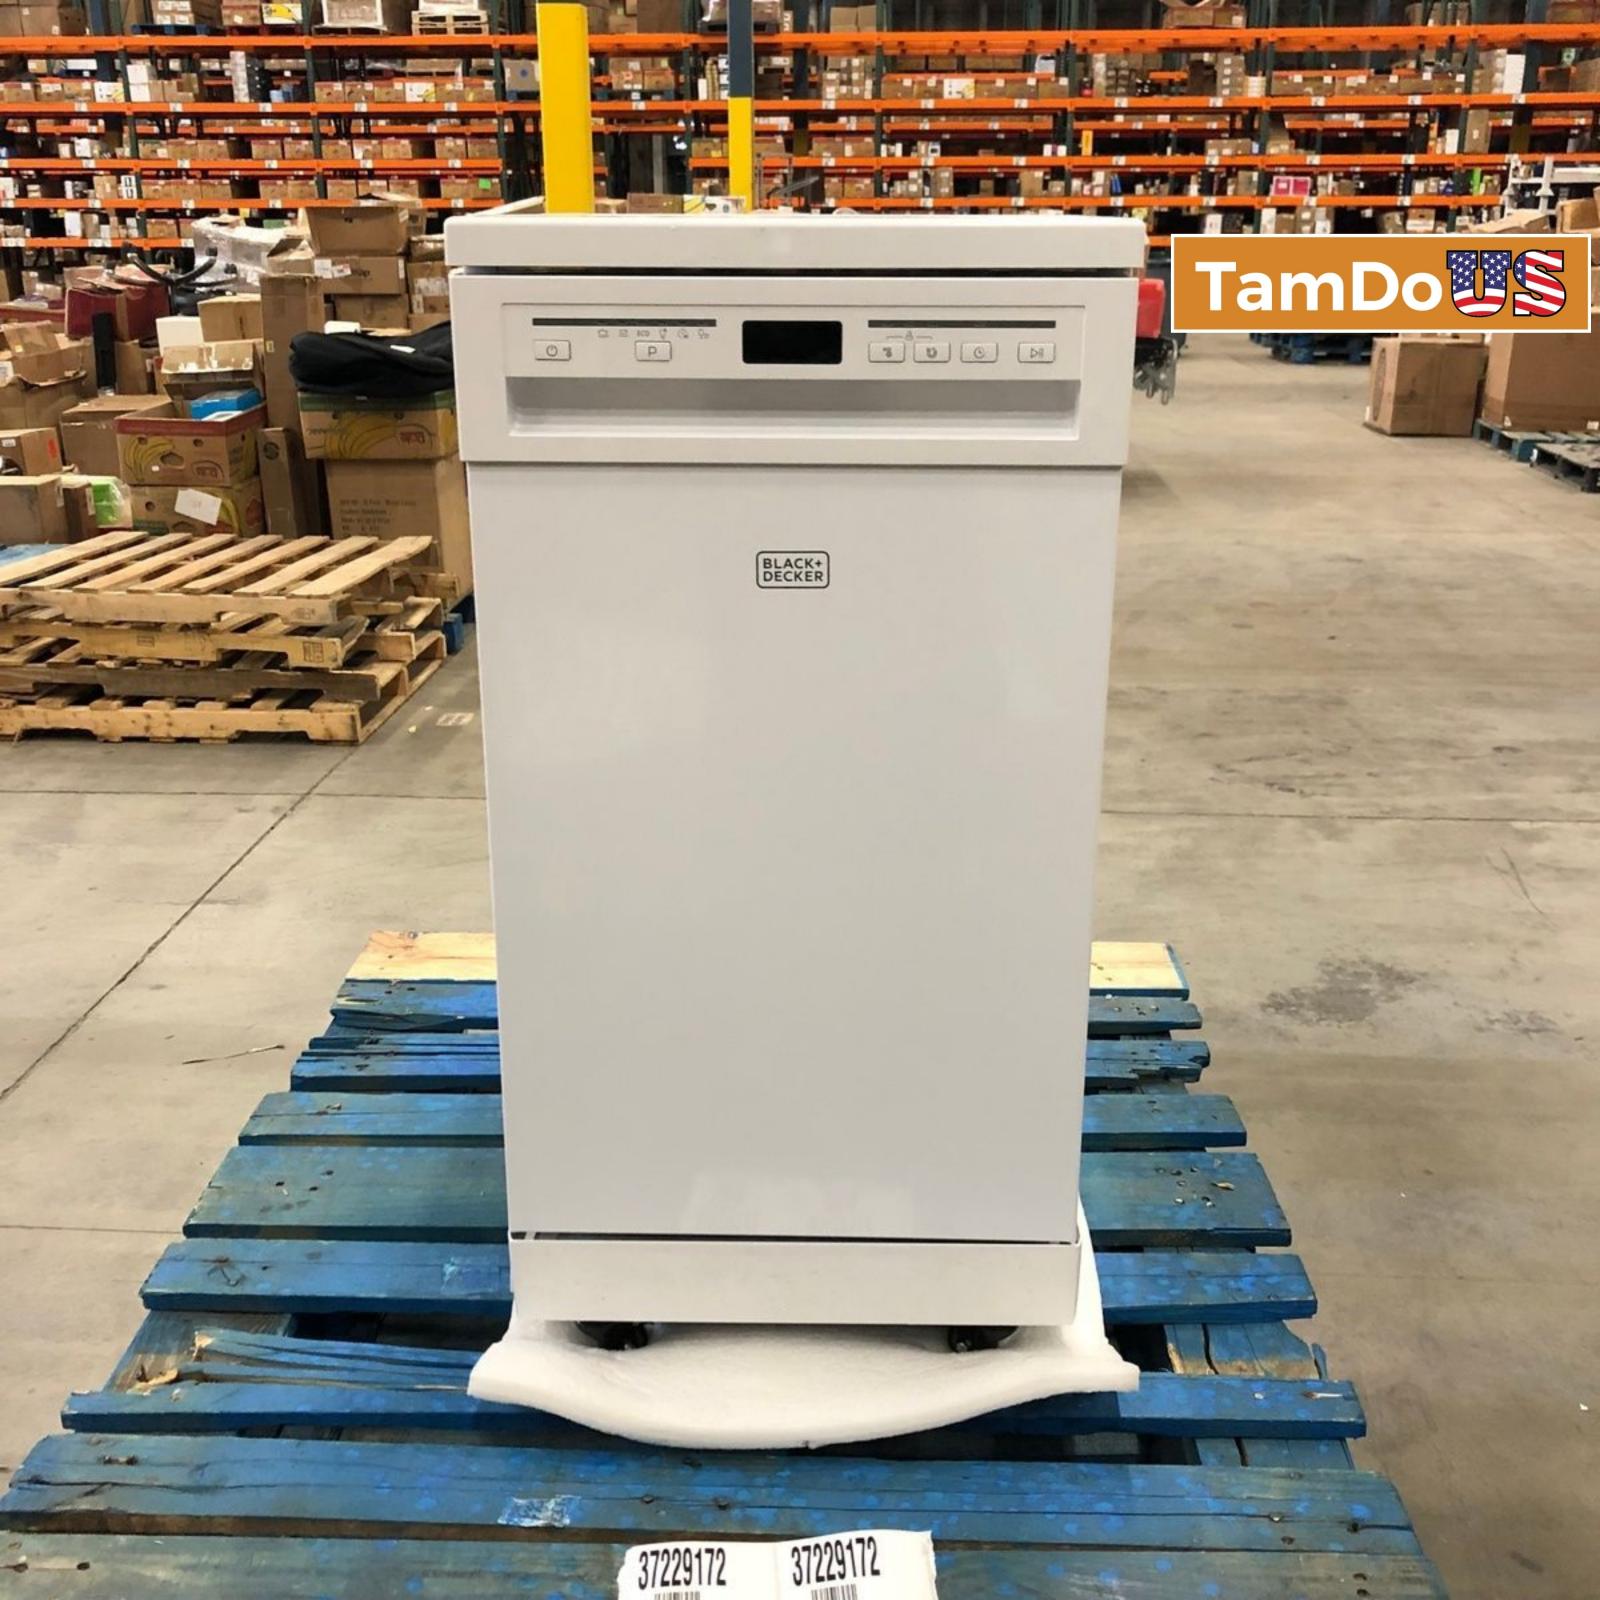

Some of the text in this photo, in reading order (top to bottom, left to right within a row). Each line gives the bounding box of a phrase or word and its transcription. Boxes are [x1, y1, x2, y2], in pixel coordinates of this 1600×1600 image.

[647, 345, 658, 357] P
[762, 557, 823, 569] BLACK+
[763, 570, 824, 582] DECKER
[791, 1535, 881, 1587] 37229172
[638, 1546, 727, 1590] 37229172
